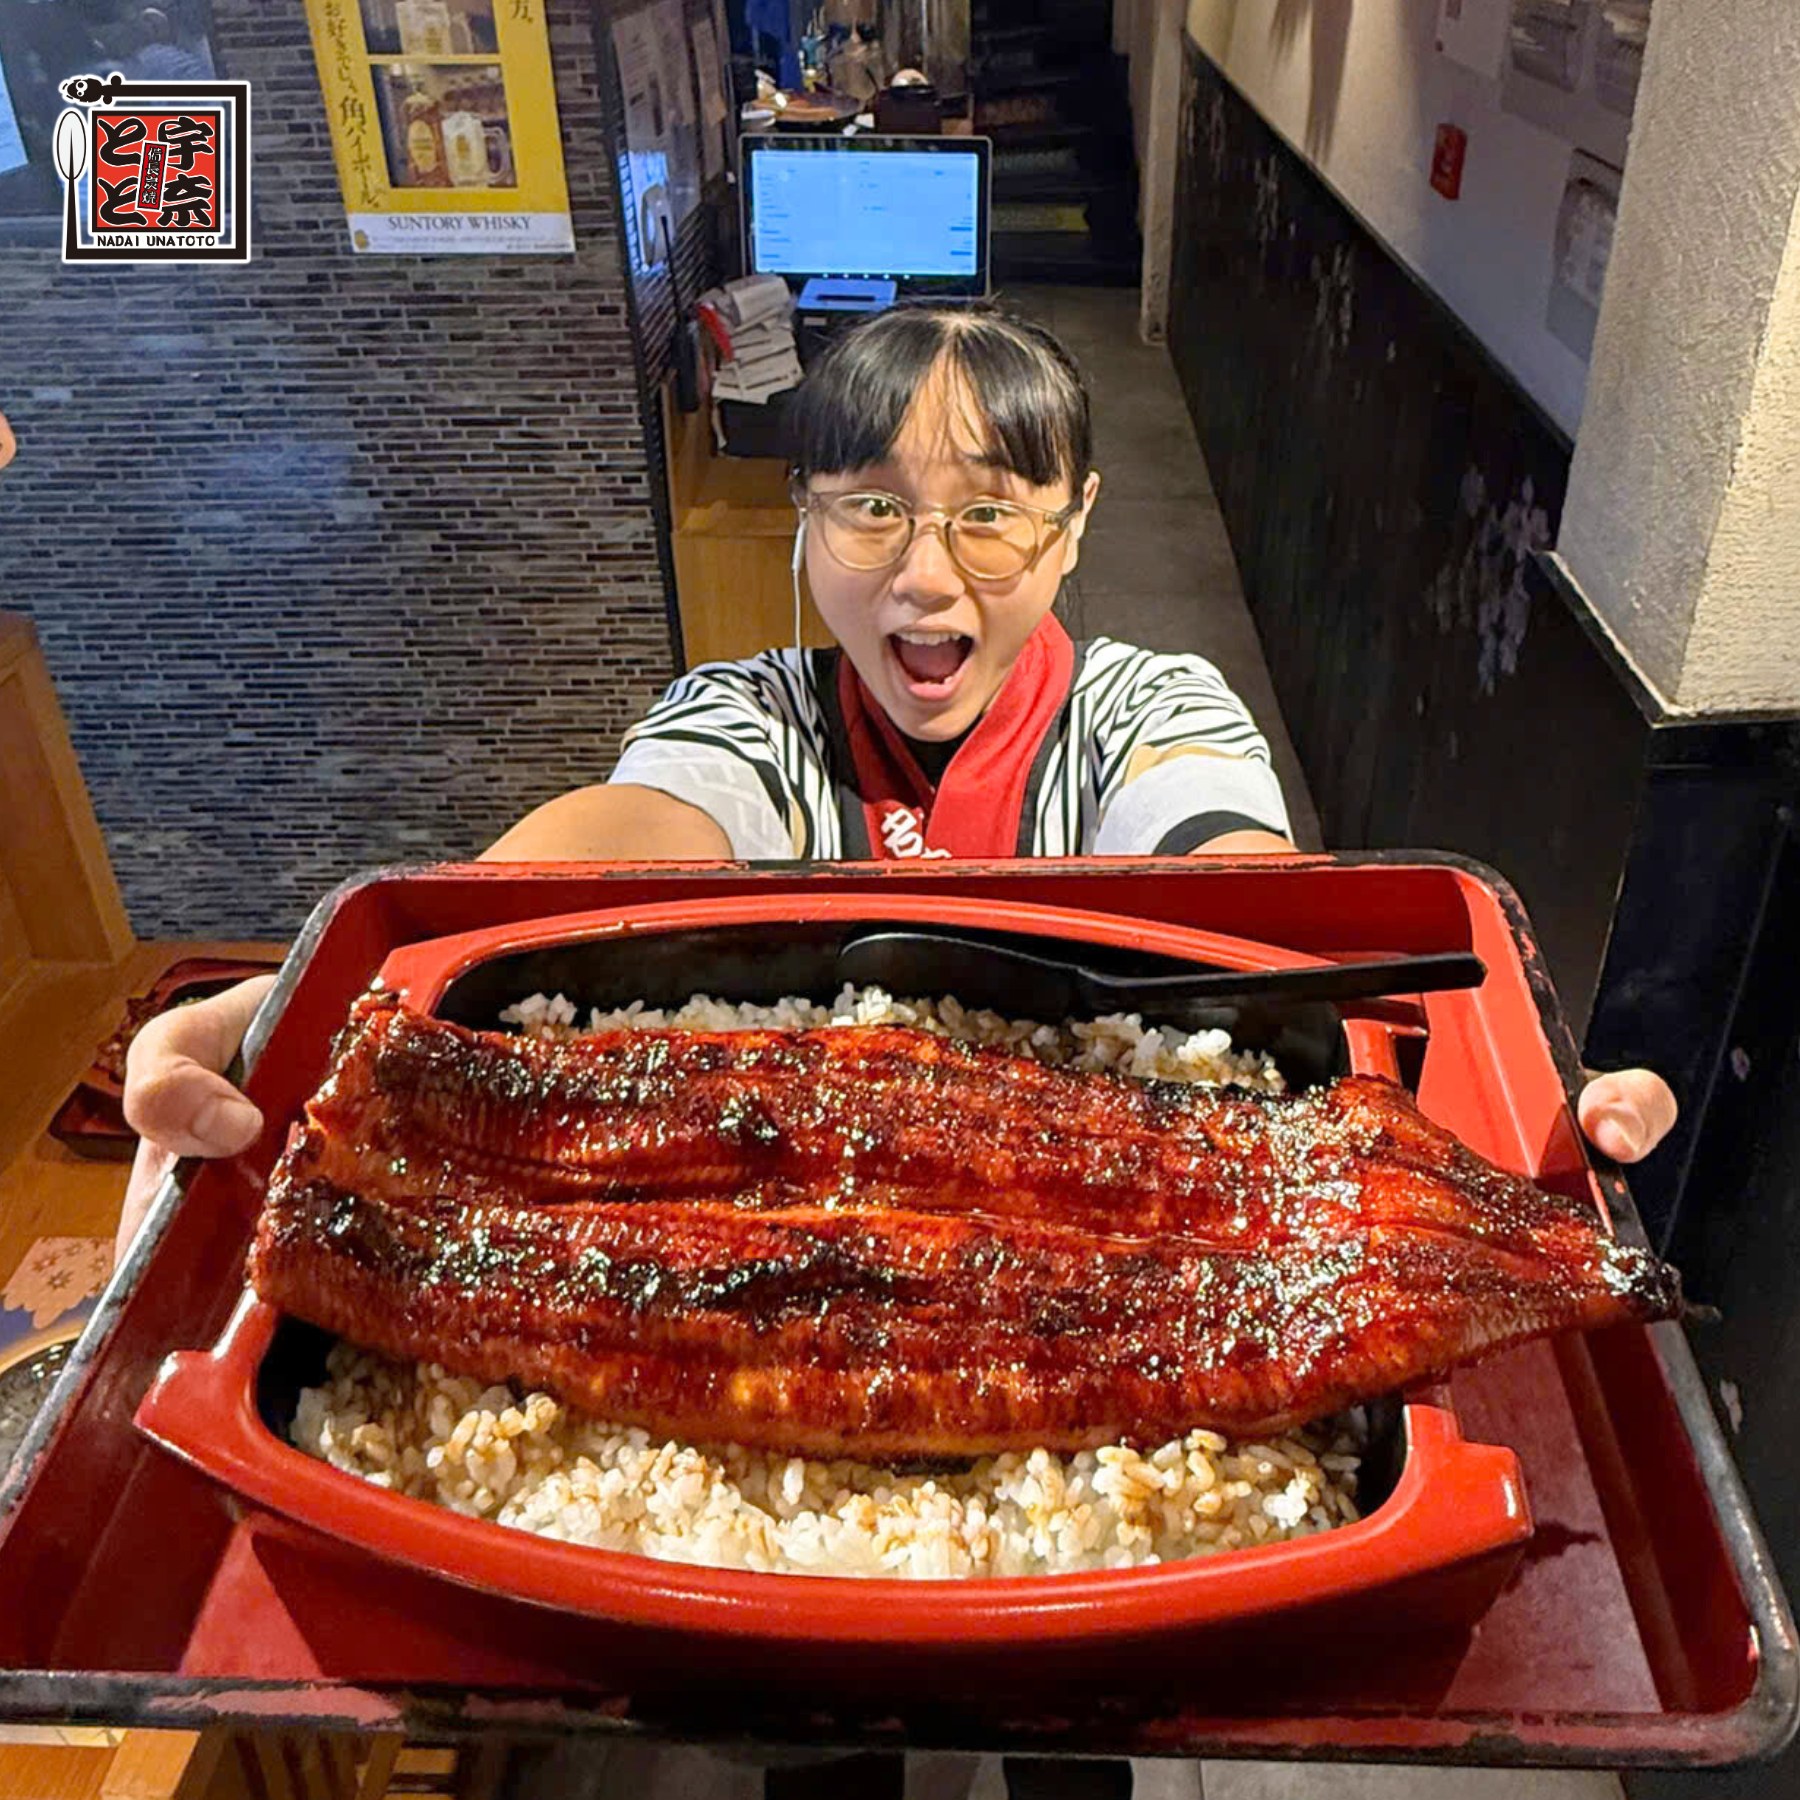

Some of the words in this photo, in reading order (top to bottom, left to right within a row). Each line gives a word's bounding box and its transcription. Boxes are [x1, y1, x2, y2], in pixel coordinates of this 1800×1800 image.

[388, 215, 464, 231] SUNTORY
[468, 215, 531, 230] WHISKY
[881, 808, 952, 859] 名
